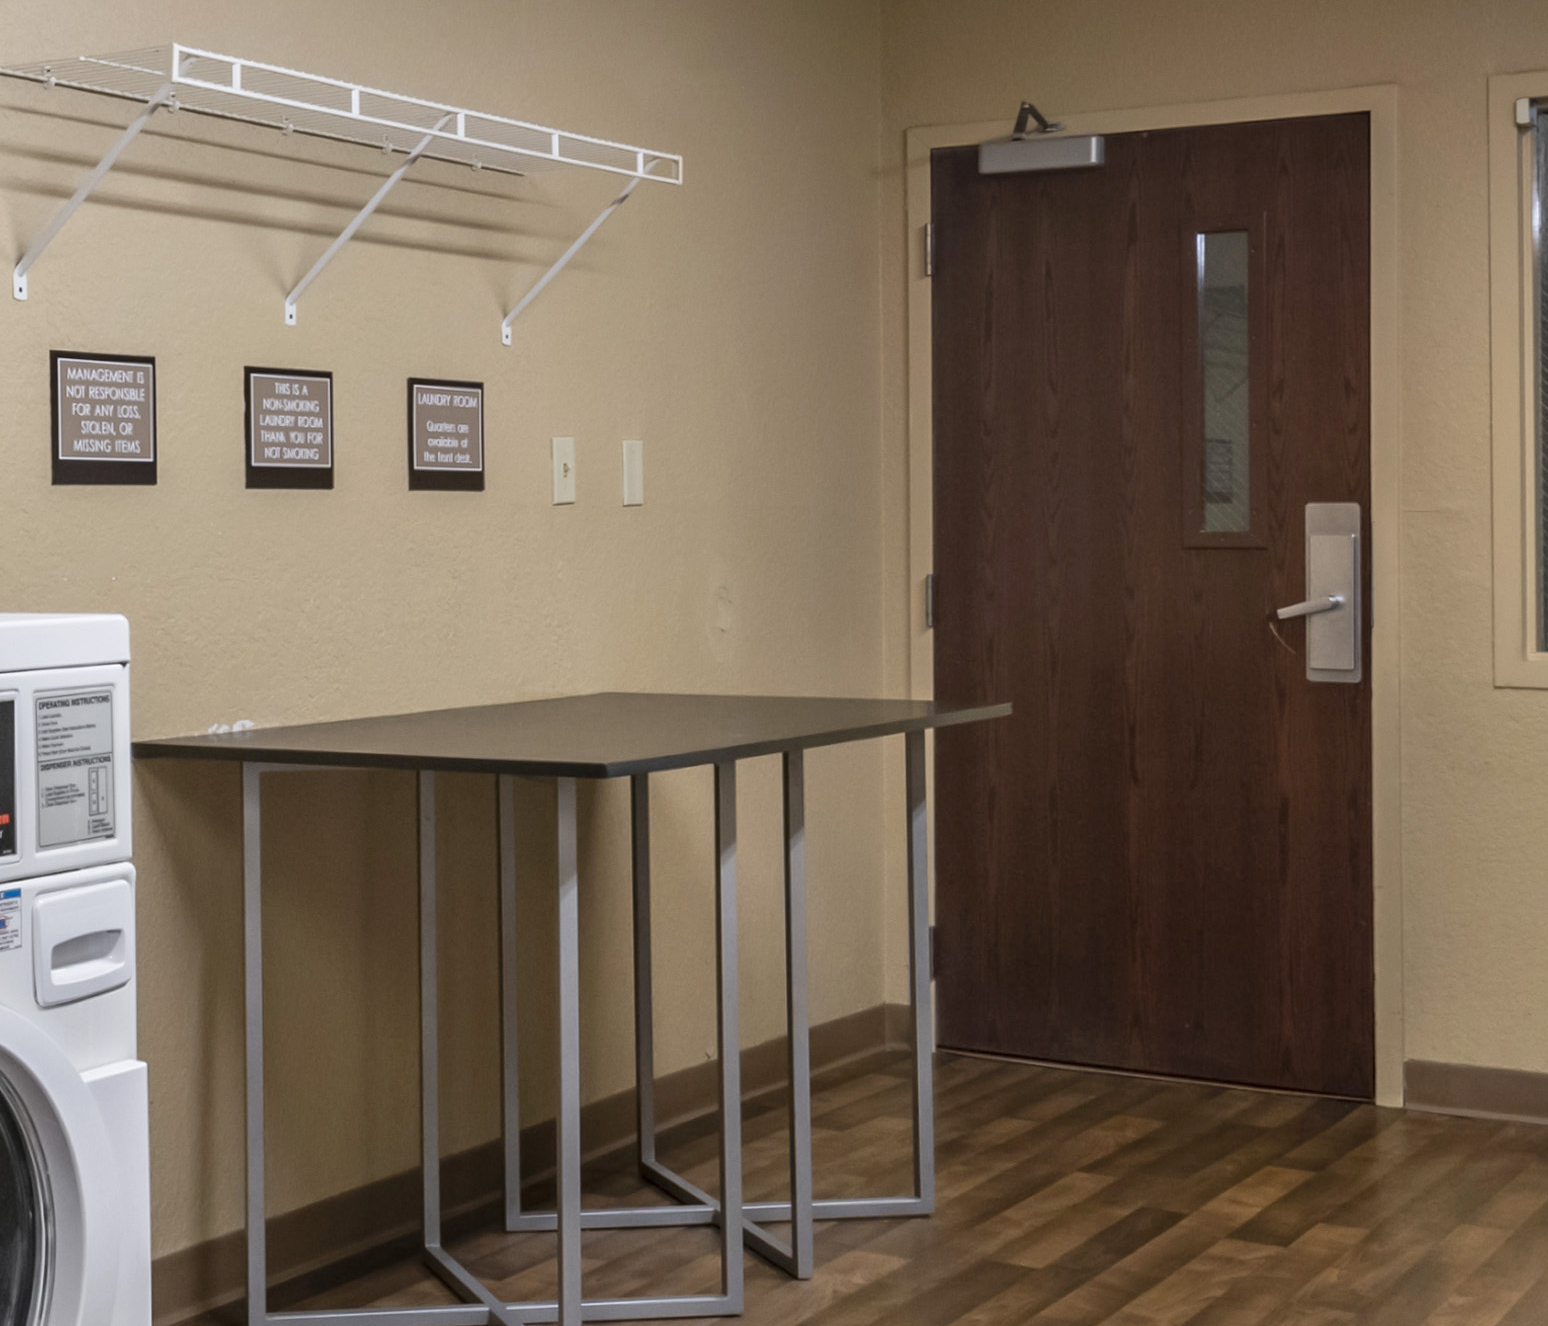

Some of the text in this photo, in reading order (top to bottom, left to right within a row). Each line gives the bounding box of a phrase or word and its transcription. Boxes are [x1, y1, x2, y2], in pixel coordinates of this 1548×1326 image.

[66, 367, 145, 384] MANAGEMENT IS
[65, 385, 145, 402] NOT RESPONSIBLE
[275, 382, 309, 396] THIS IS A
[262, 398, 320, 413] NON-SMOKING
[418, 392, 478, 408] LAUNDRY ROOM
[71, 403, 141, 419] FOR ANY LOSS,
[80, 421, 133, 436] STOLEN, OR
[259, 414, 324, 428] LAUNDRY ROOM
[426, 420, 456, 433] Quarters
[260, 430, 324, 445] THANK YOU FOR
[73, 440, 141, 454] MISSING ITEMS
[264, 447, 320, 461] NOT SMOKING
